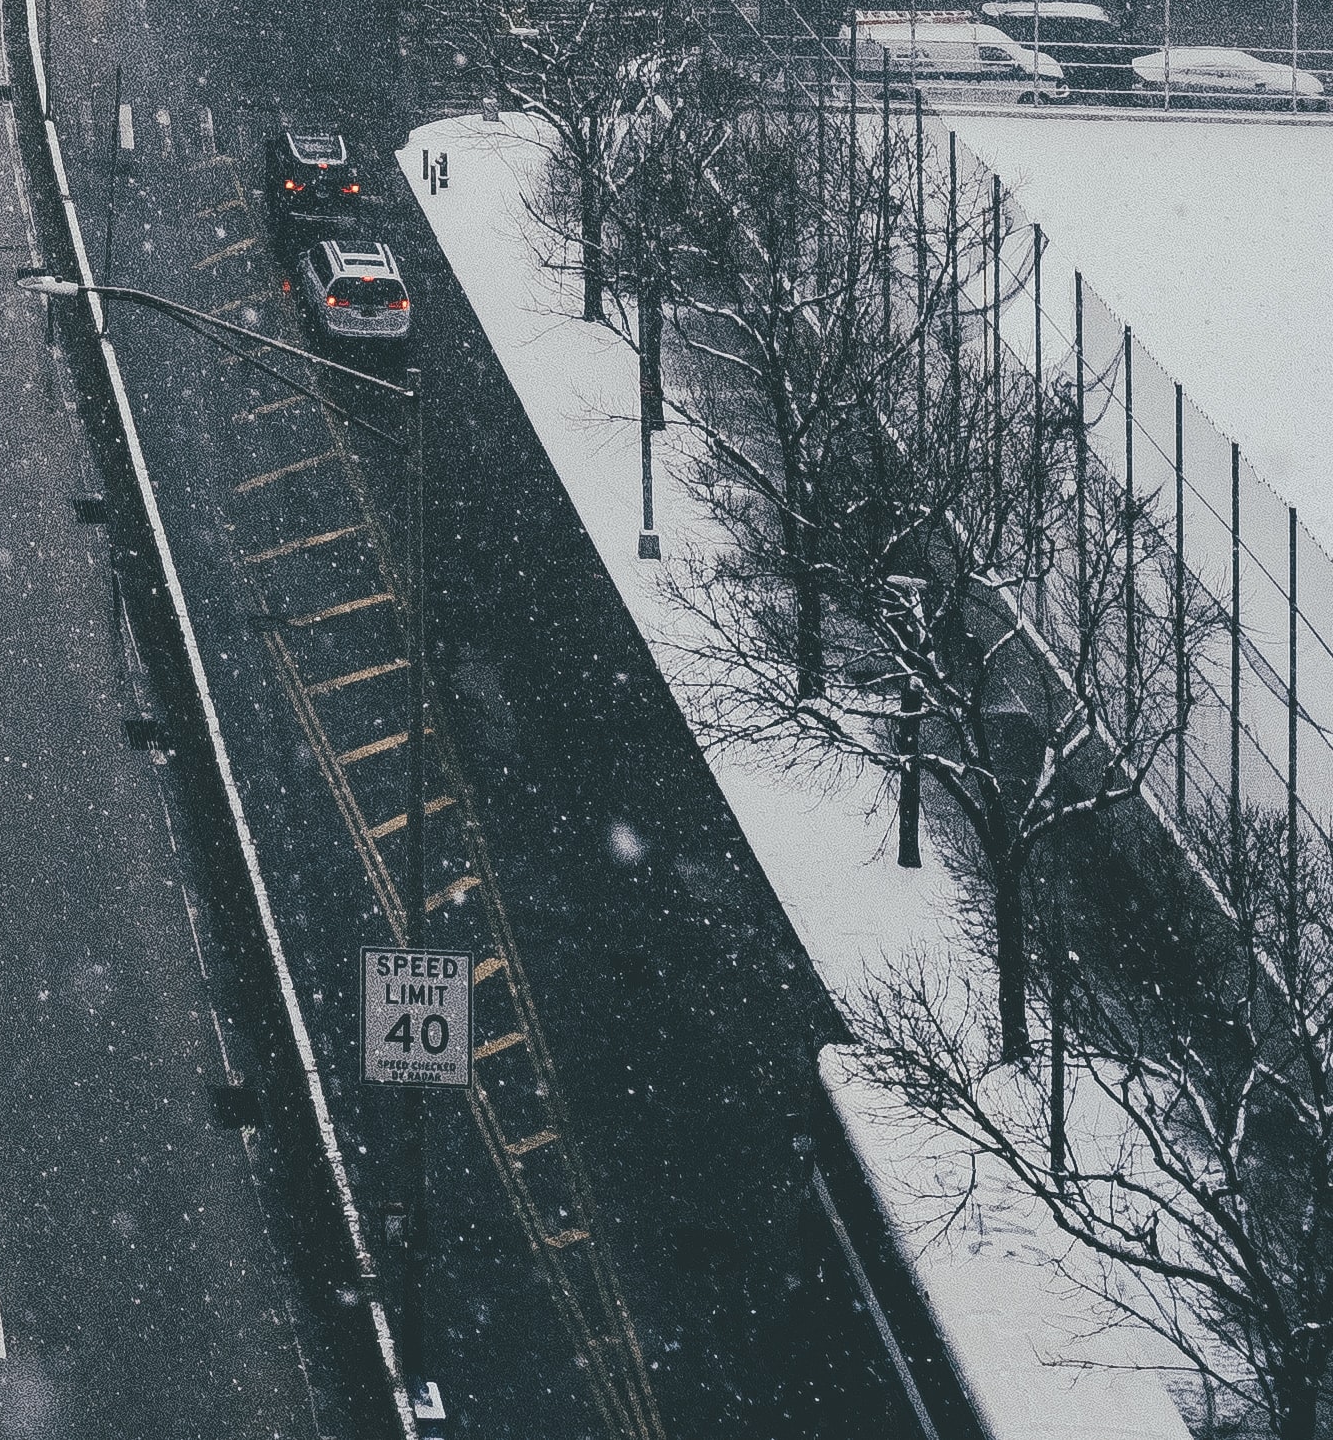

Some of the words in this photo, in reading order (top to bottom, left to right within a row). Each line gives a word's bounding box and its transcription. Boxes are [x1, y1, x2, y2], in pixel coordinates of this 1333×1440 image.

[376, 954, 459, 979] SPEED
[385, 984, 449, 1006] LIMIT
[384, 1013, 450, 1055] 40
[377, 1059, 409, 1071] SPEED
[411, 1061, 457, 1073] CHECKED
[407, 1071, 442, 1082] RADAR
